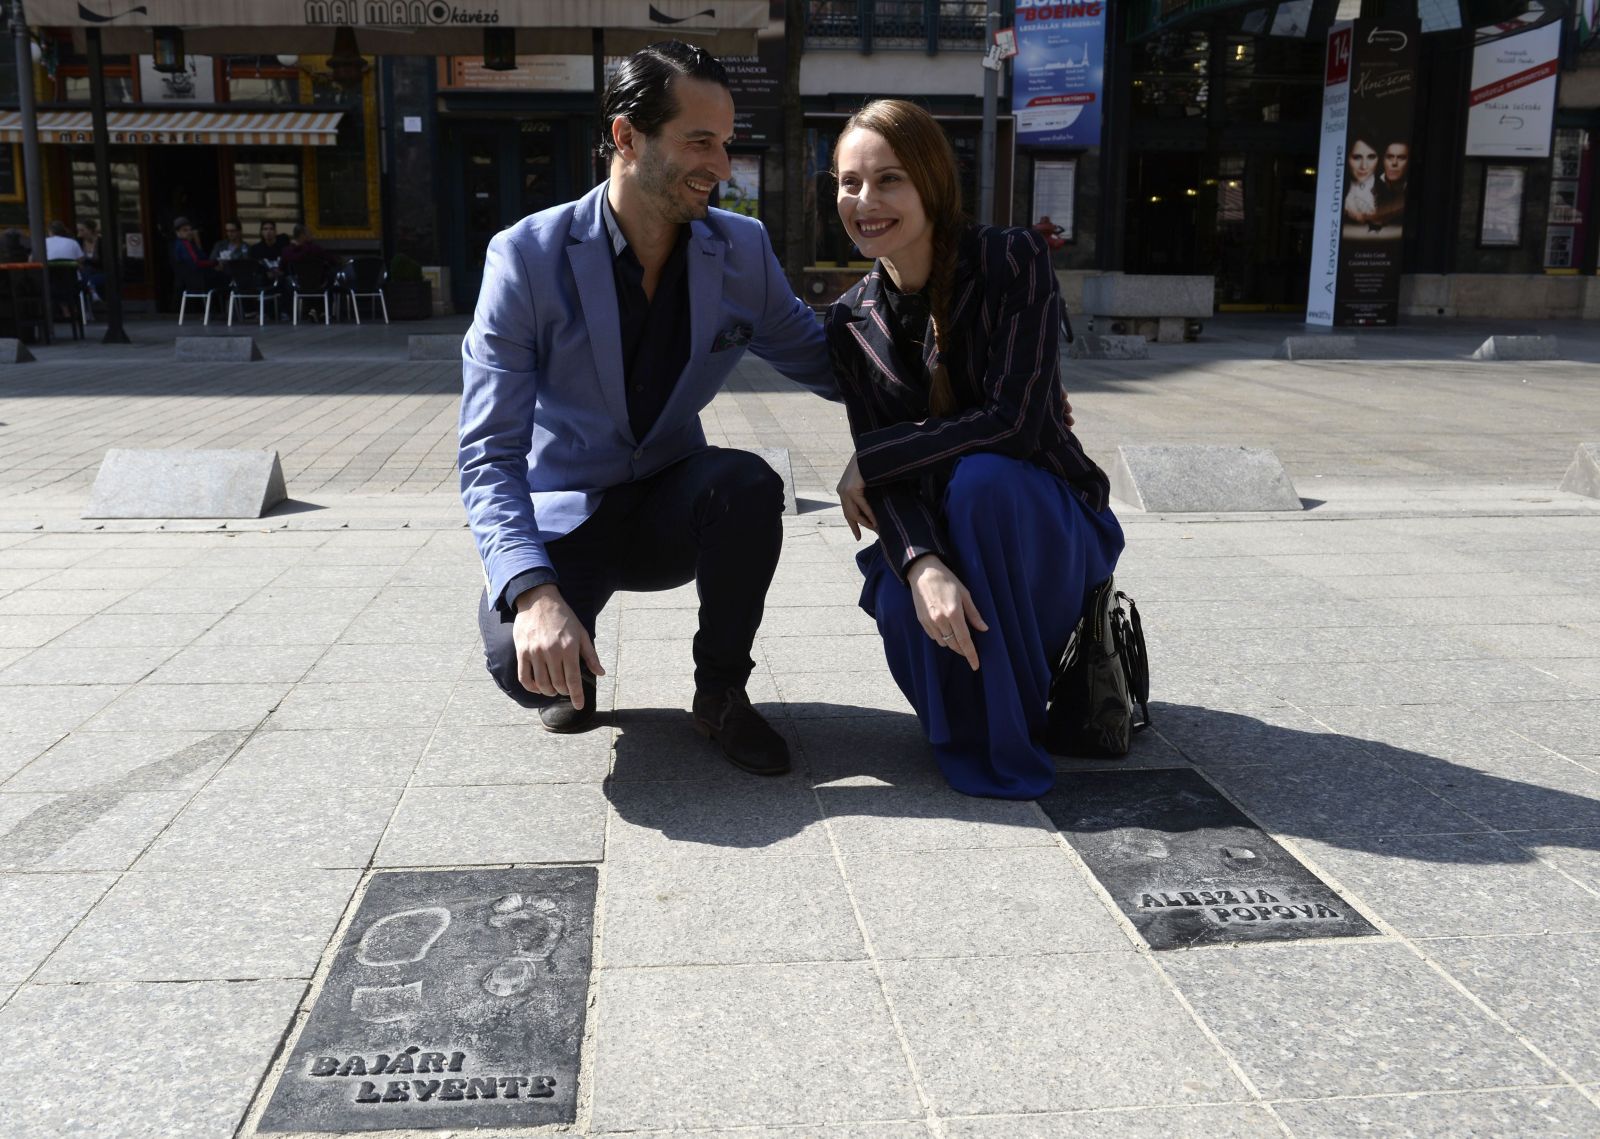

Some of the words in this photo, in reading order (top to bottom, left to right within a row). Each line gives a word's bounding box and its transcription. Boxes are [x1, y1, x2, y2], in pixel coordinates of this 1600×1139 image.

[304, 0, 357, 24] MAI
[365, 0, 451, 25] MANO
[451, 7, 500, 24] kávézó
[1024, 3, 1102, 21] BOEING
[1334, 32, 1349, 67] 14
[1330, 145, 1344, 213] ünnepe
[1326, 219, 1339, 276] tavasz
[1325, 282, 1334, 294] A
[1210, 904, 1339, 923] POPOVA
[308, 1046, 466, 1077] BAJÁRI
[355, 1075, 557, 1103] LEVENTE
